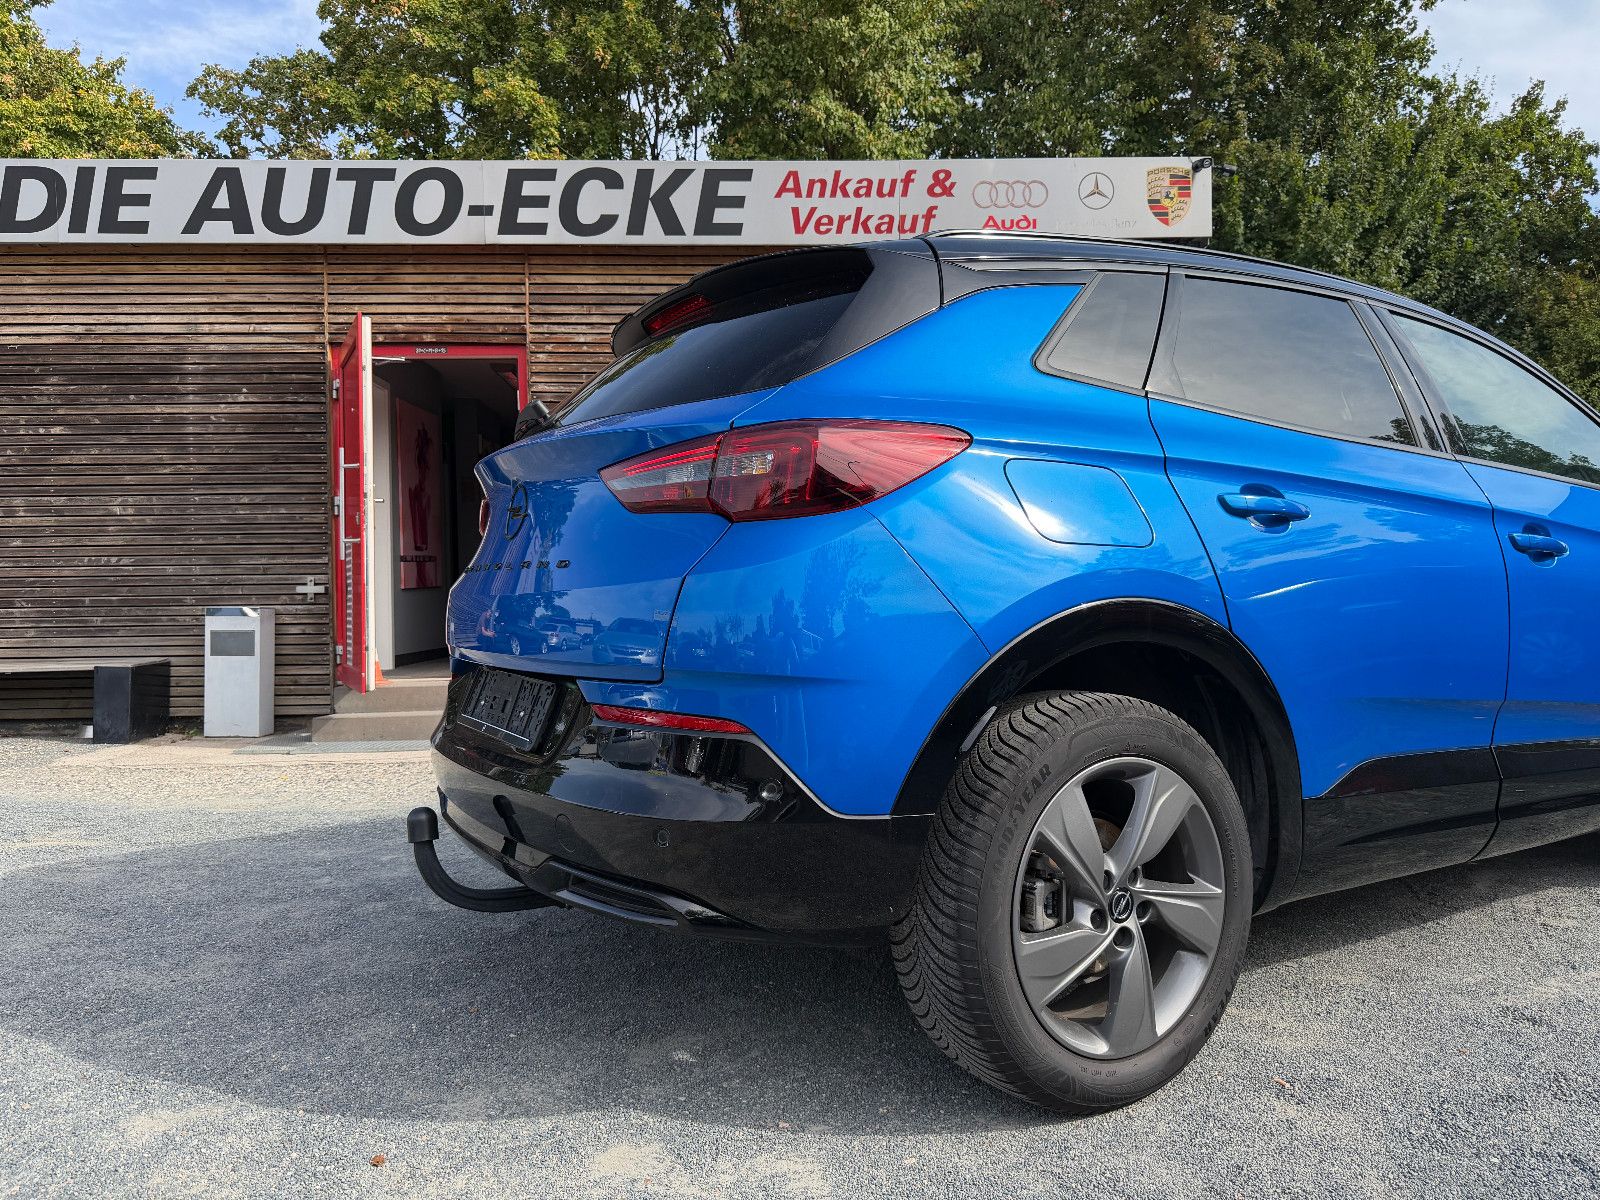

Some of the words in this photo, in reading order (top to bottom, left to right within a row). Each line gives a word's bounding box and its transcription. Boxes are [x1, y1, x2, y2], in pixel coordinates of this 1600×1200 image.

[774, 169, 917, 199] Ankauf
[926, 168, 957, 198] &
[0, 165, 159, 234] DIE
[180, 165, 754, 237] AUTO-ECKE
[790, 205, 939, 235] Verkauf
[982, 214, 1037, 230] Audi
